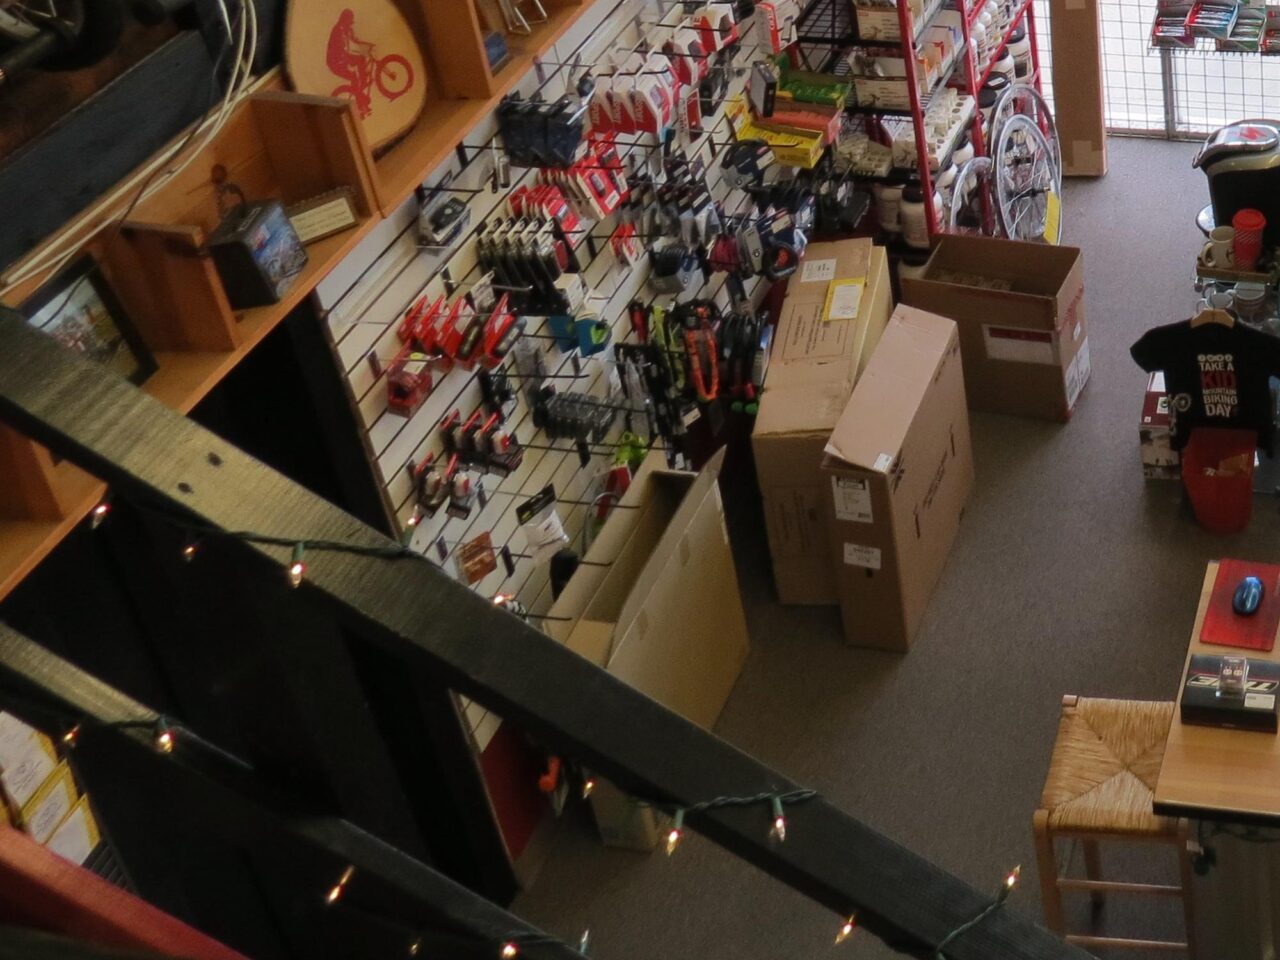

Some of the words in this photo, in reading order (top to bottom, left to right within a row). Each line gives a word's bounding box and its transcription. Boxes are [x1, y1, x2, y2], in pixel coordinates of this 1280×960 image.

[1200, 362, 1225, 372] TAKE
[1227, 362, 1235, 372] A
[1201, 371, 1237, 389] KID
[1203, 394, 1238, 405] BIKING
[1205, 404, 1231, 418] DAY
